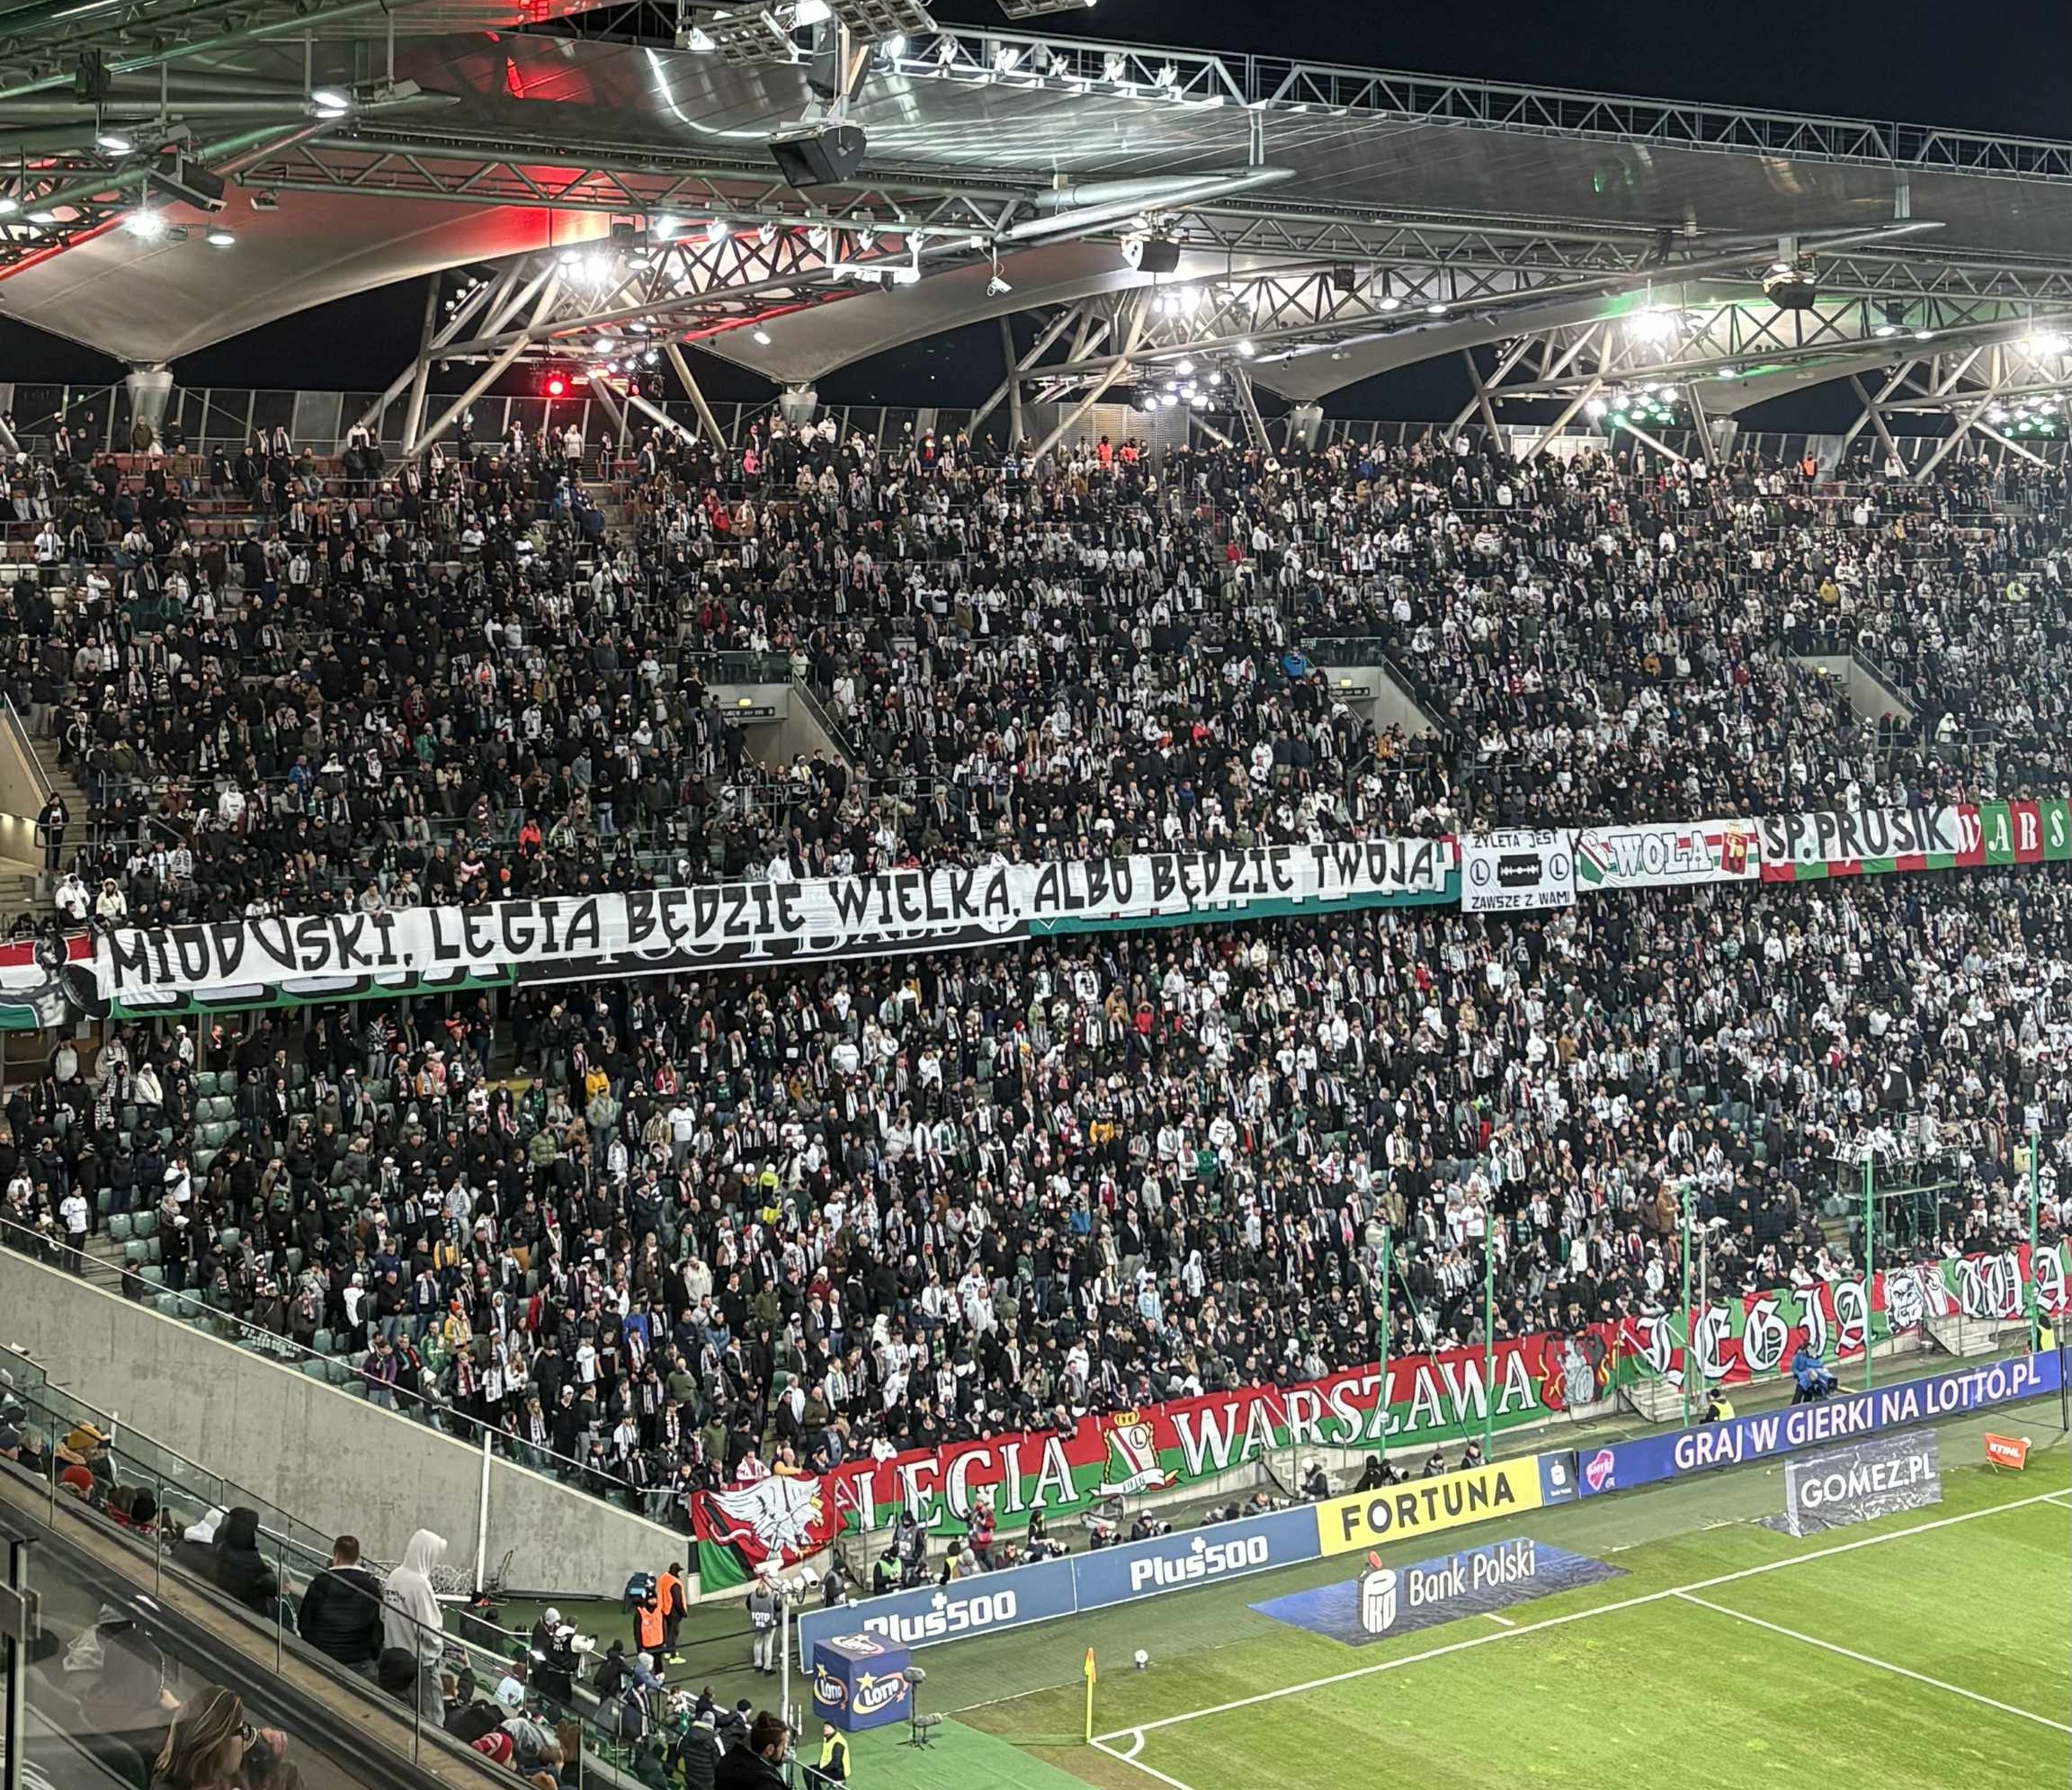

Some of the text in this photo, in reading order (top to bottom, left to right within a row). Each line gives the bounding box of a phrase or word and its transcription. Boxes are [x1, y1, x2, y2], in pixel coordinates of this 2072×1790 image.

[1528, 827, 1558, 848] JEST
[1609, 830, 1713, 877] WOLA
[430, 898, 600, 961] LEGIA
[1034, 857, 1132, 913] ALBO
[1471, 894, 1521, 909] ZAWSZE
[1525, 893, 1533, 907] Z
[852, 1349, 1538, 1534] LEGIA WARSZAWA
[1675, 1356, 2041, 1470] GRAJ W GIERKI NA LOTTO.PL
[1341, 1472, 1515, 1542] FORTUNA
[1800, 1452, 1936, 1508] GOMEZ.PL
[1130, 1535, 1269, 1591] Plus500
[1409, 1557, 1466, 1607] Bank
[1473, 1540, 1535, 1590] Polski
